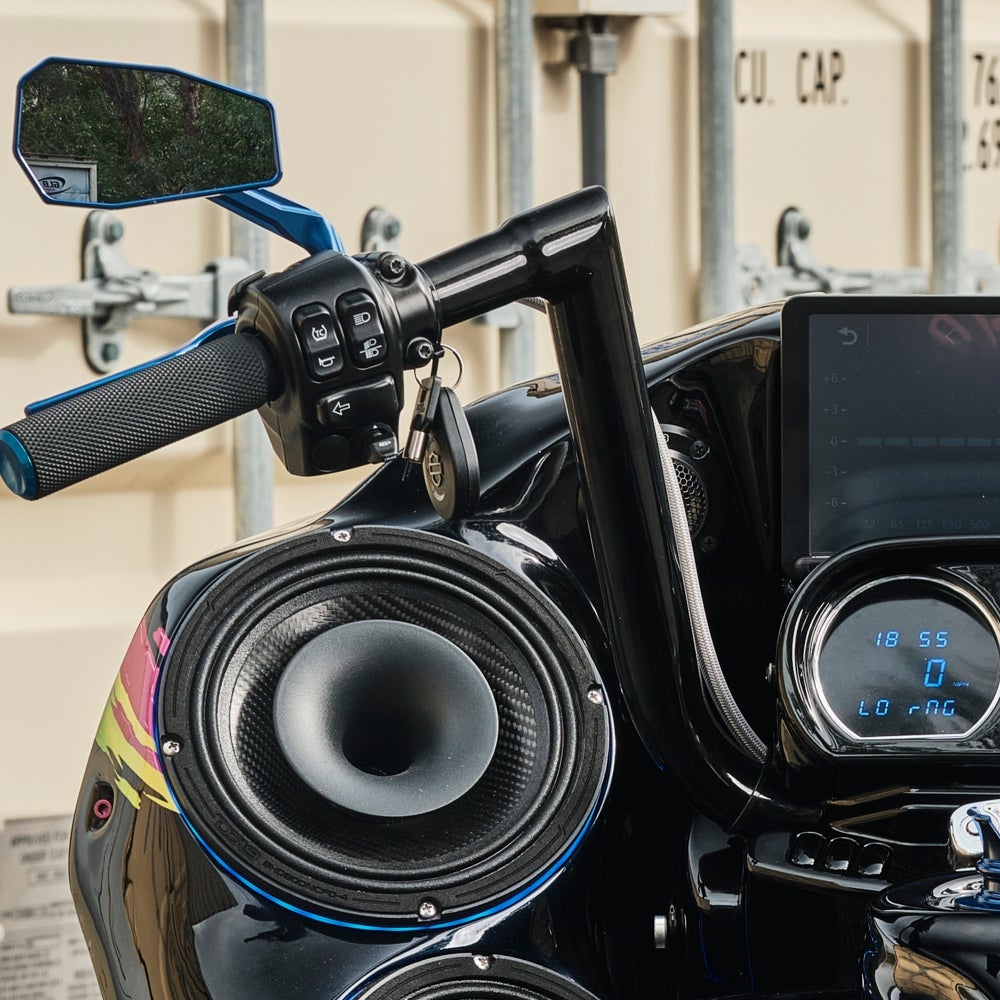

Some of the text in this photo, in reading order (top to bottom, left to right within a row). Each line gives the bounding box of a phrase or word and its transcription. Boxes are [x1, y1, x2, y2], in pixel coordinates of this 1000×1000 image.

[735, 51, 849, 106] CU. CAP.
[876, 631, 899, 648] 18
[923, 658, 947, 688] 0
